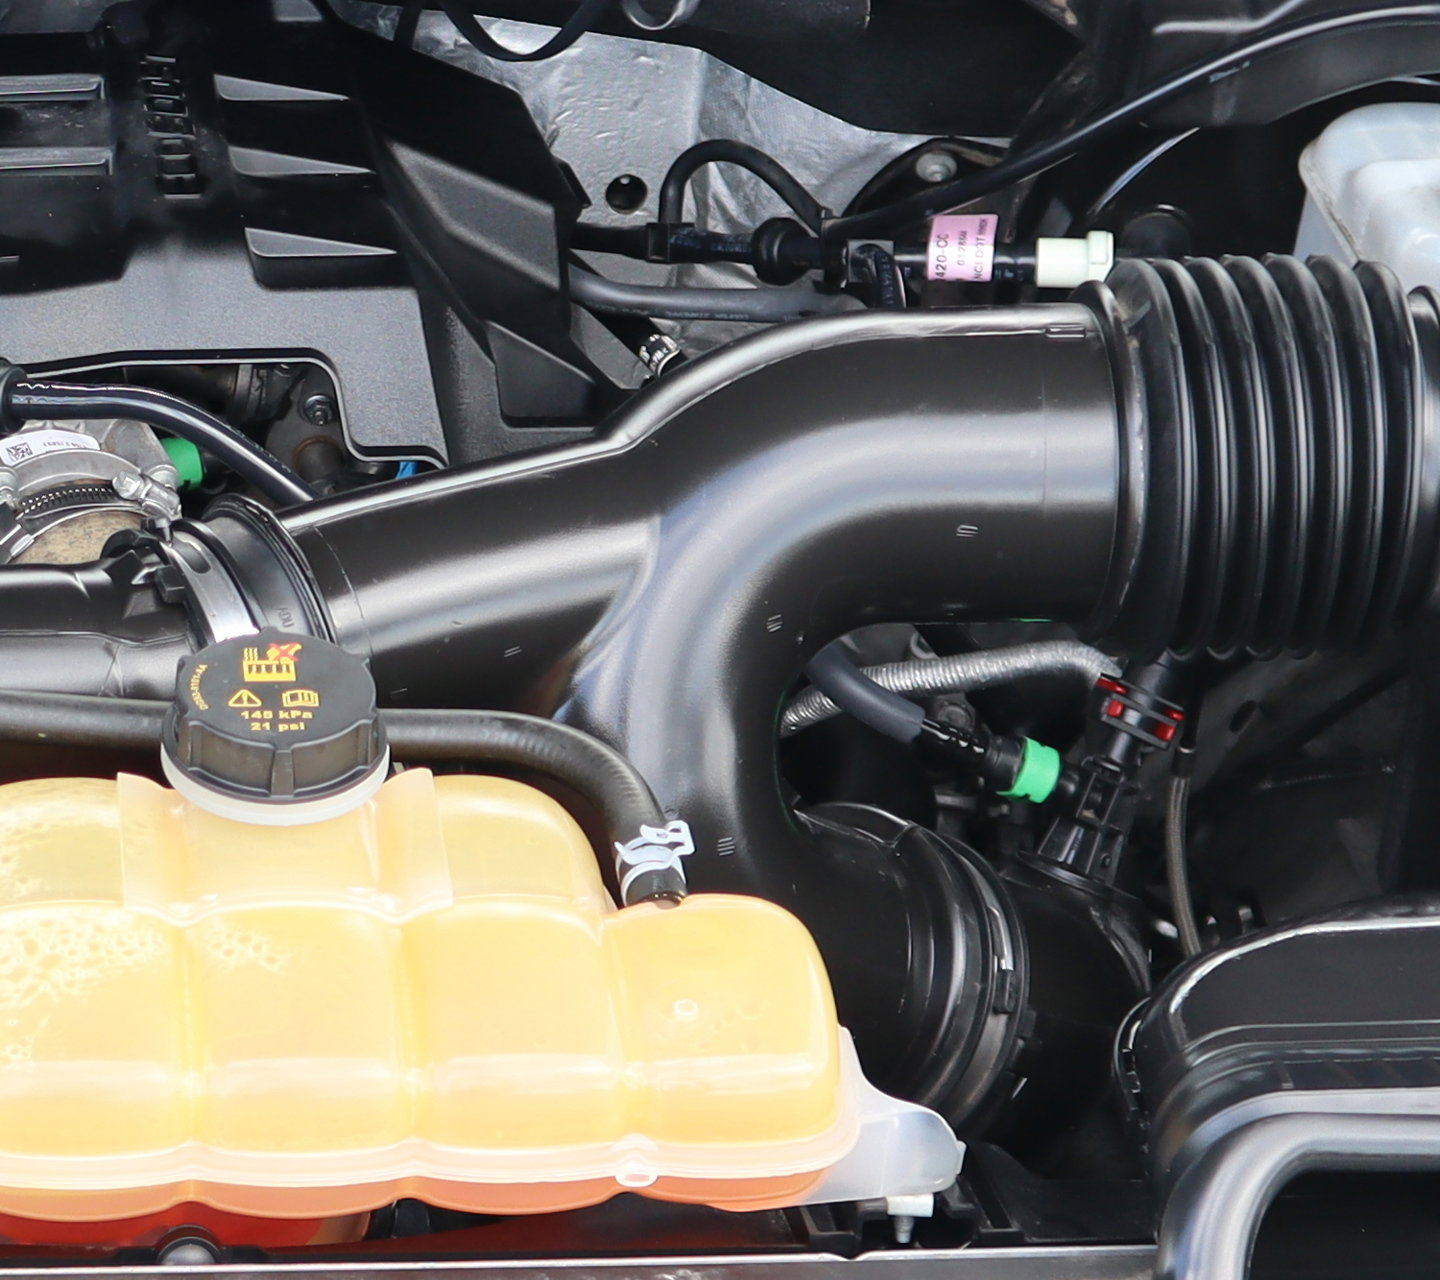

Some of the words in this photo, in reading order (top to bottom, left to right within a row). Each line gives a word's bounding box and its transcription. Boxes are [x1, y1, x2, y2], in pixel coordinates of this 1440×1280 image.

[278, 709, 313, 720] kPa
[249, 722, 272, 732] 21
[277, 722, 306, 733] psi
